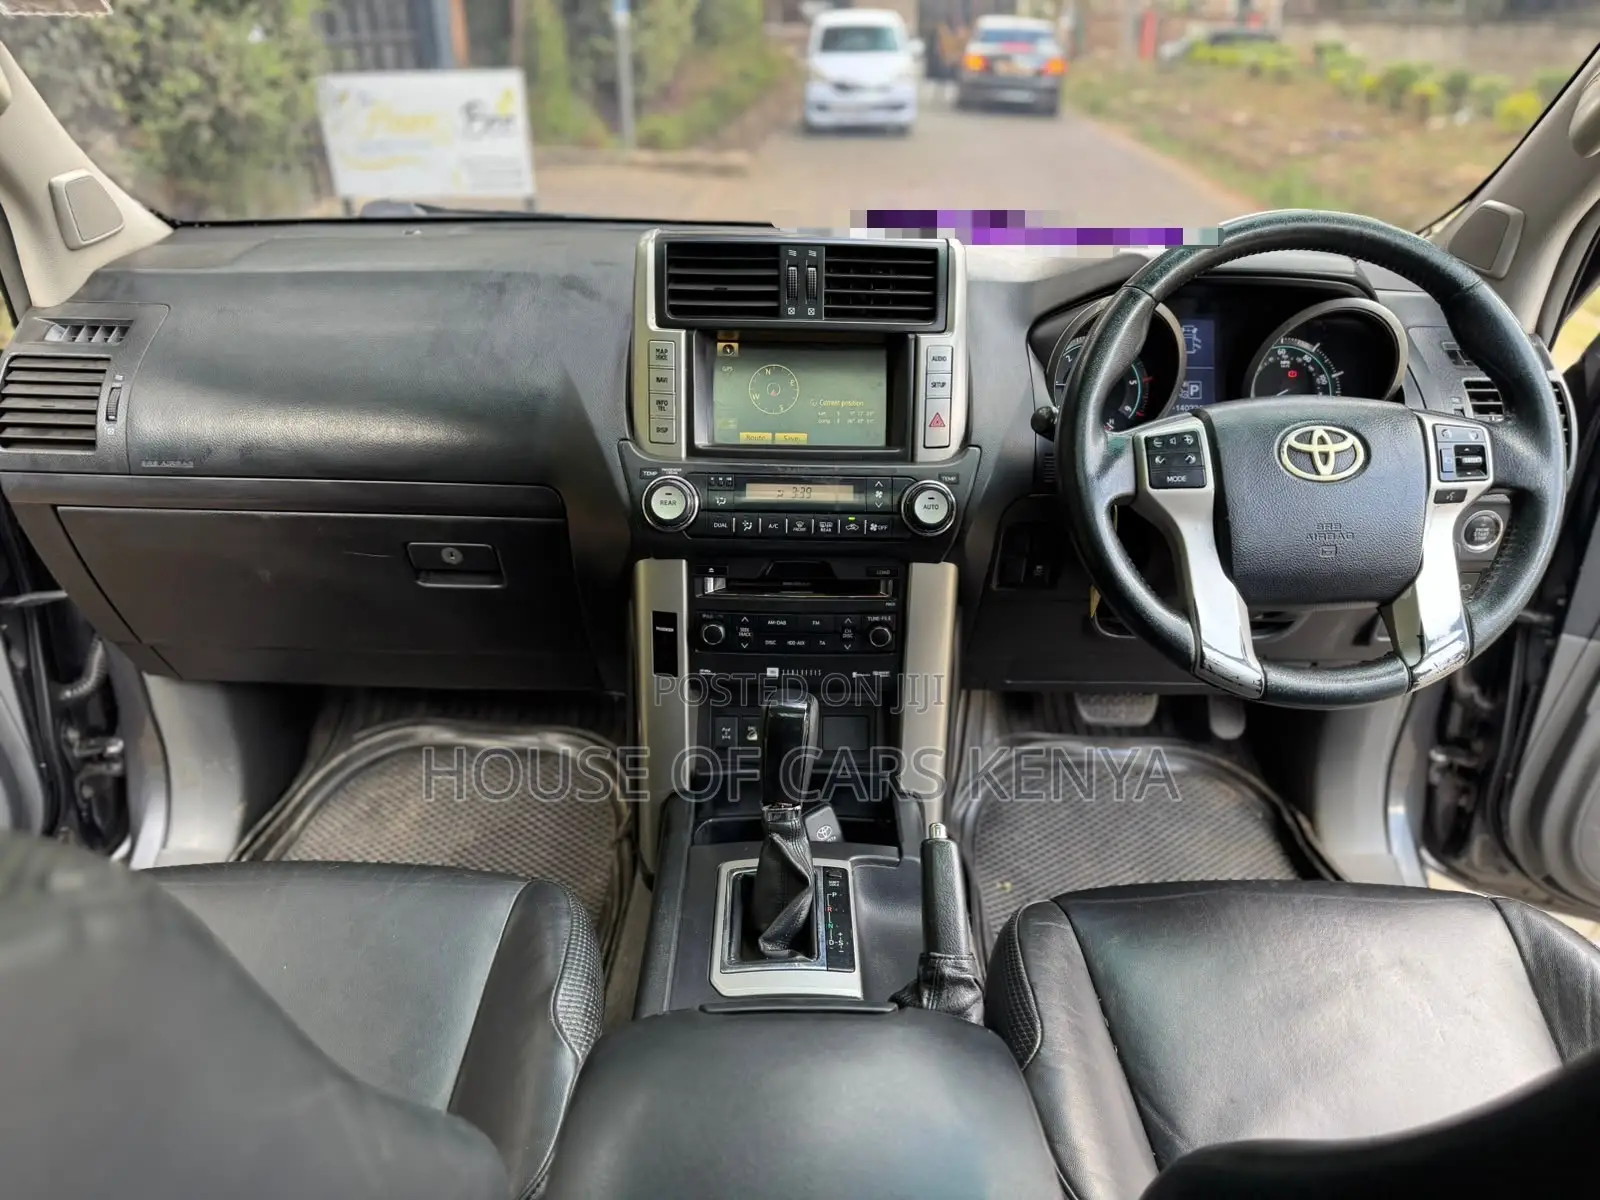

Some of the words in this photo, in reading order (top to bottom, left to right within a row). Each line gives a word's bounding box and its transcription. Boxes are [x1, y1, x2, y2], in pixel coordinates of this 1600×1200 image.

[1190, 384, 1200, 397] P
[1166, 475, 1187, 483] MODE
[923, 503, 940, 511] AUTO
